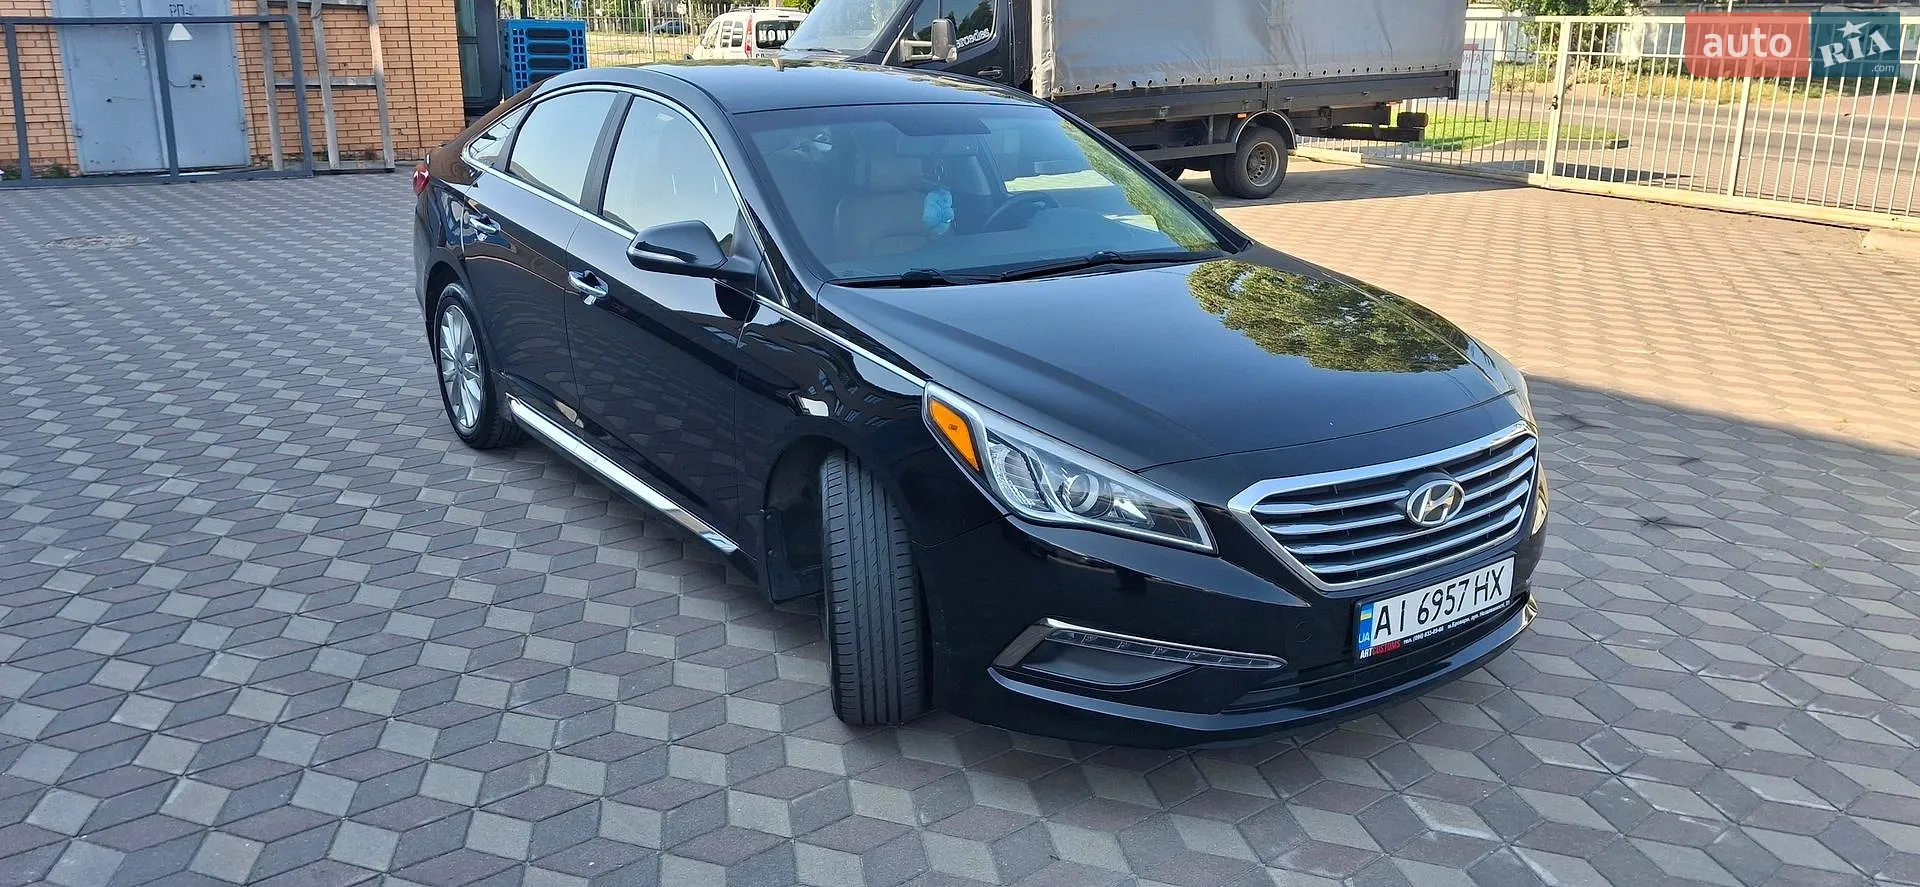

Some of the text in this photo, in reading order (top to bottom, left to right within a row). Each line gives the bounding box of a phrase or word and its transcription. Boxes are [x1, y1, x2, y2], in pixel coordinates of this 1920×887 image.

[1374, 566, 1505, 640] AI 6957 HX
[1358, 631, 1371, 644] UA
